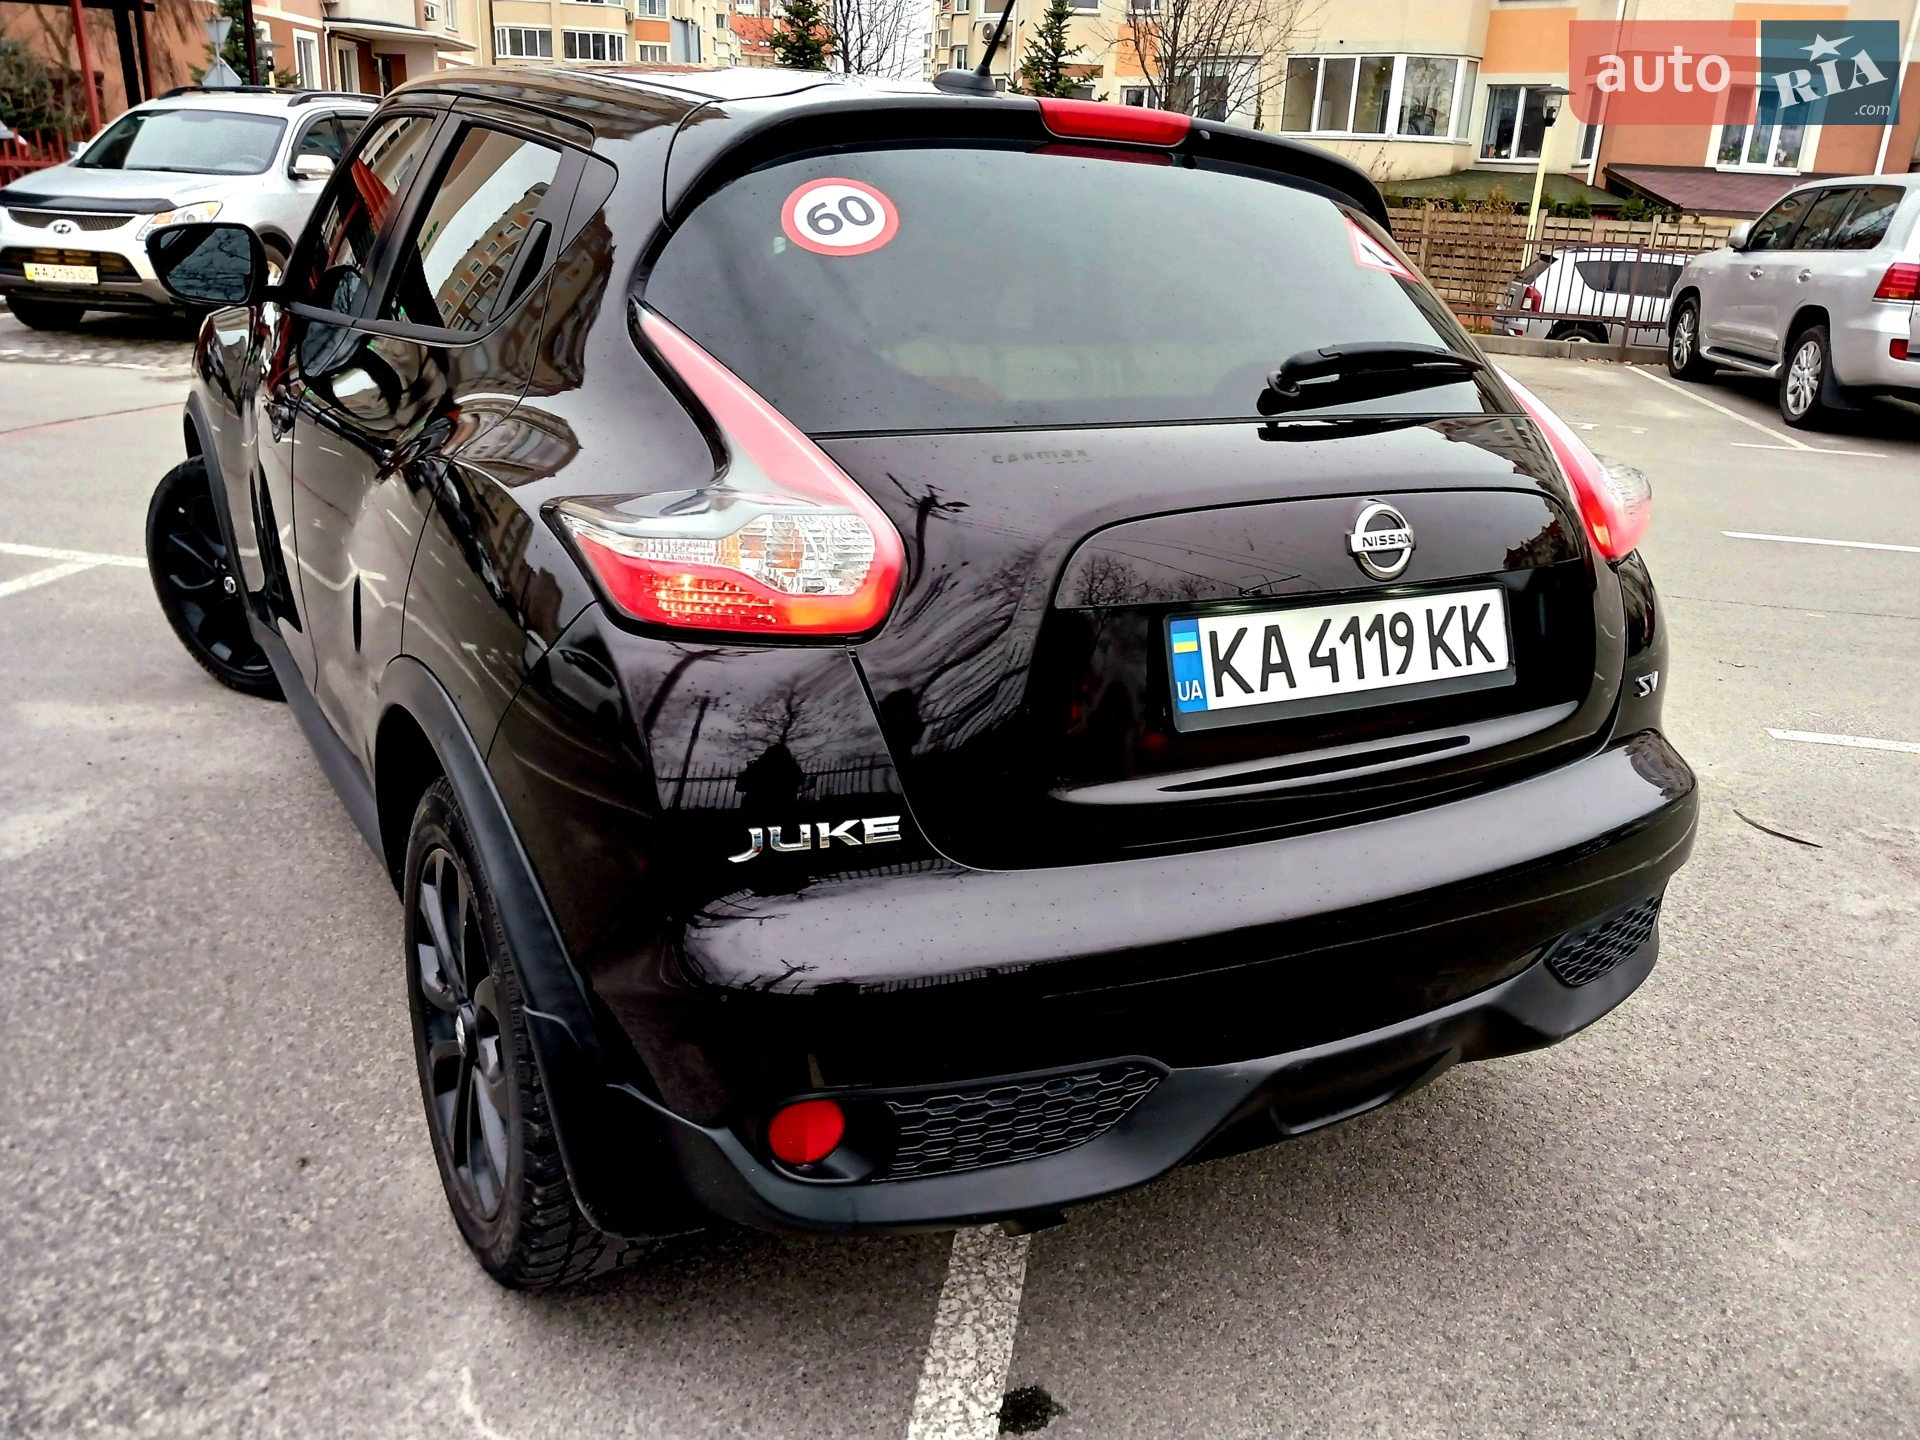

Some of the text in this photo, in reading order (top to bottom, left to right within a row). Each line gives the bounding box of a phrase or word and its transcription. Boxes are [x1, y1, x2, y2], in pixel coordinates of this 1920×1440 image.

[806, 195, 875, 236] 60
[1361, 532, 1412, 548] NISSAN
[1209, 602, 1495, 697] KA 4119 KK
[1177, 679, 1204, 702] UA
[727, 815, 902, 863] JUKE
